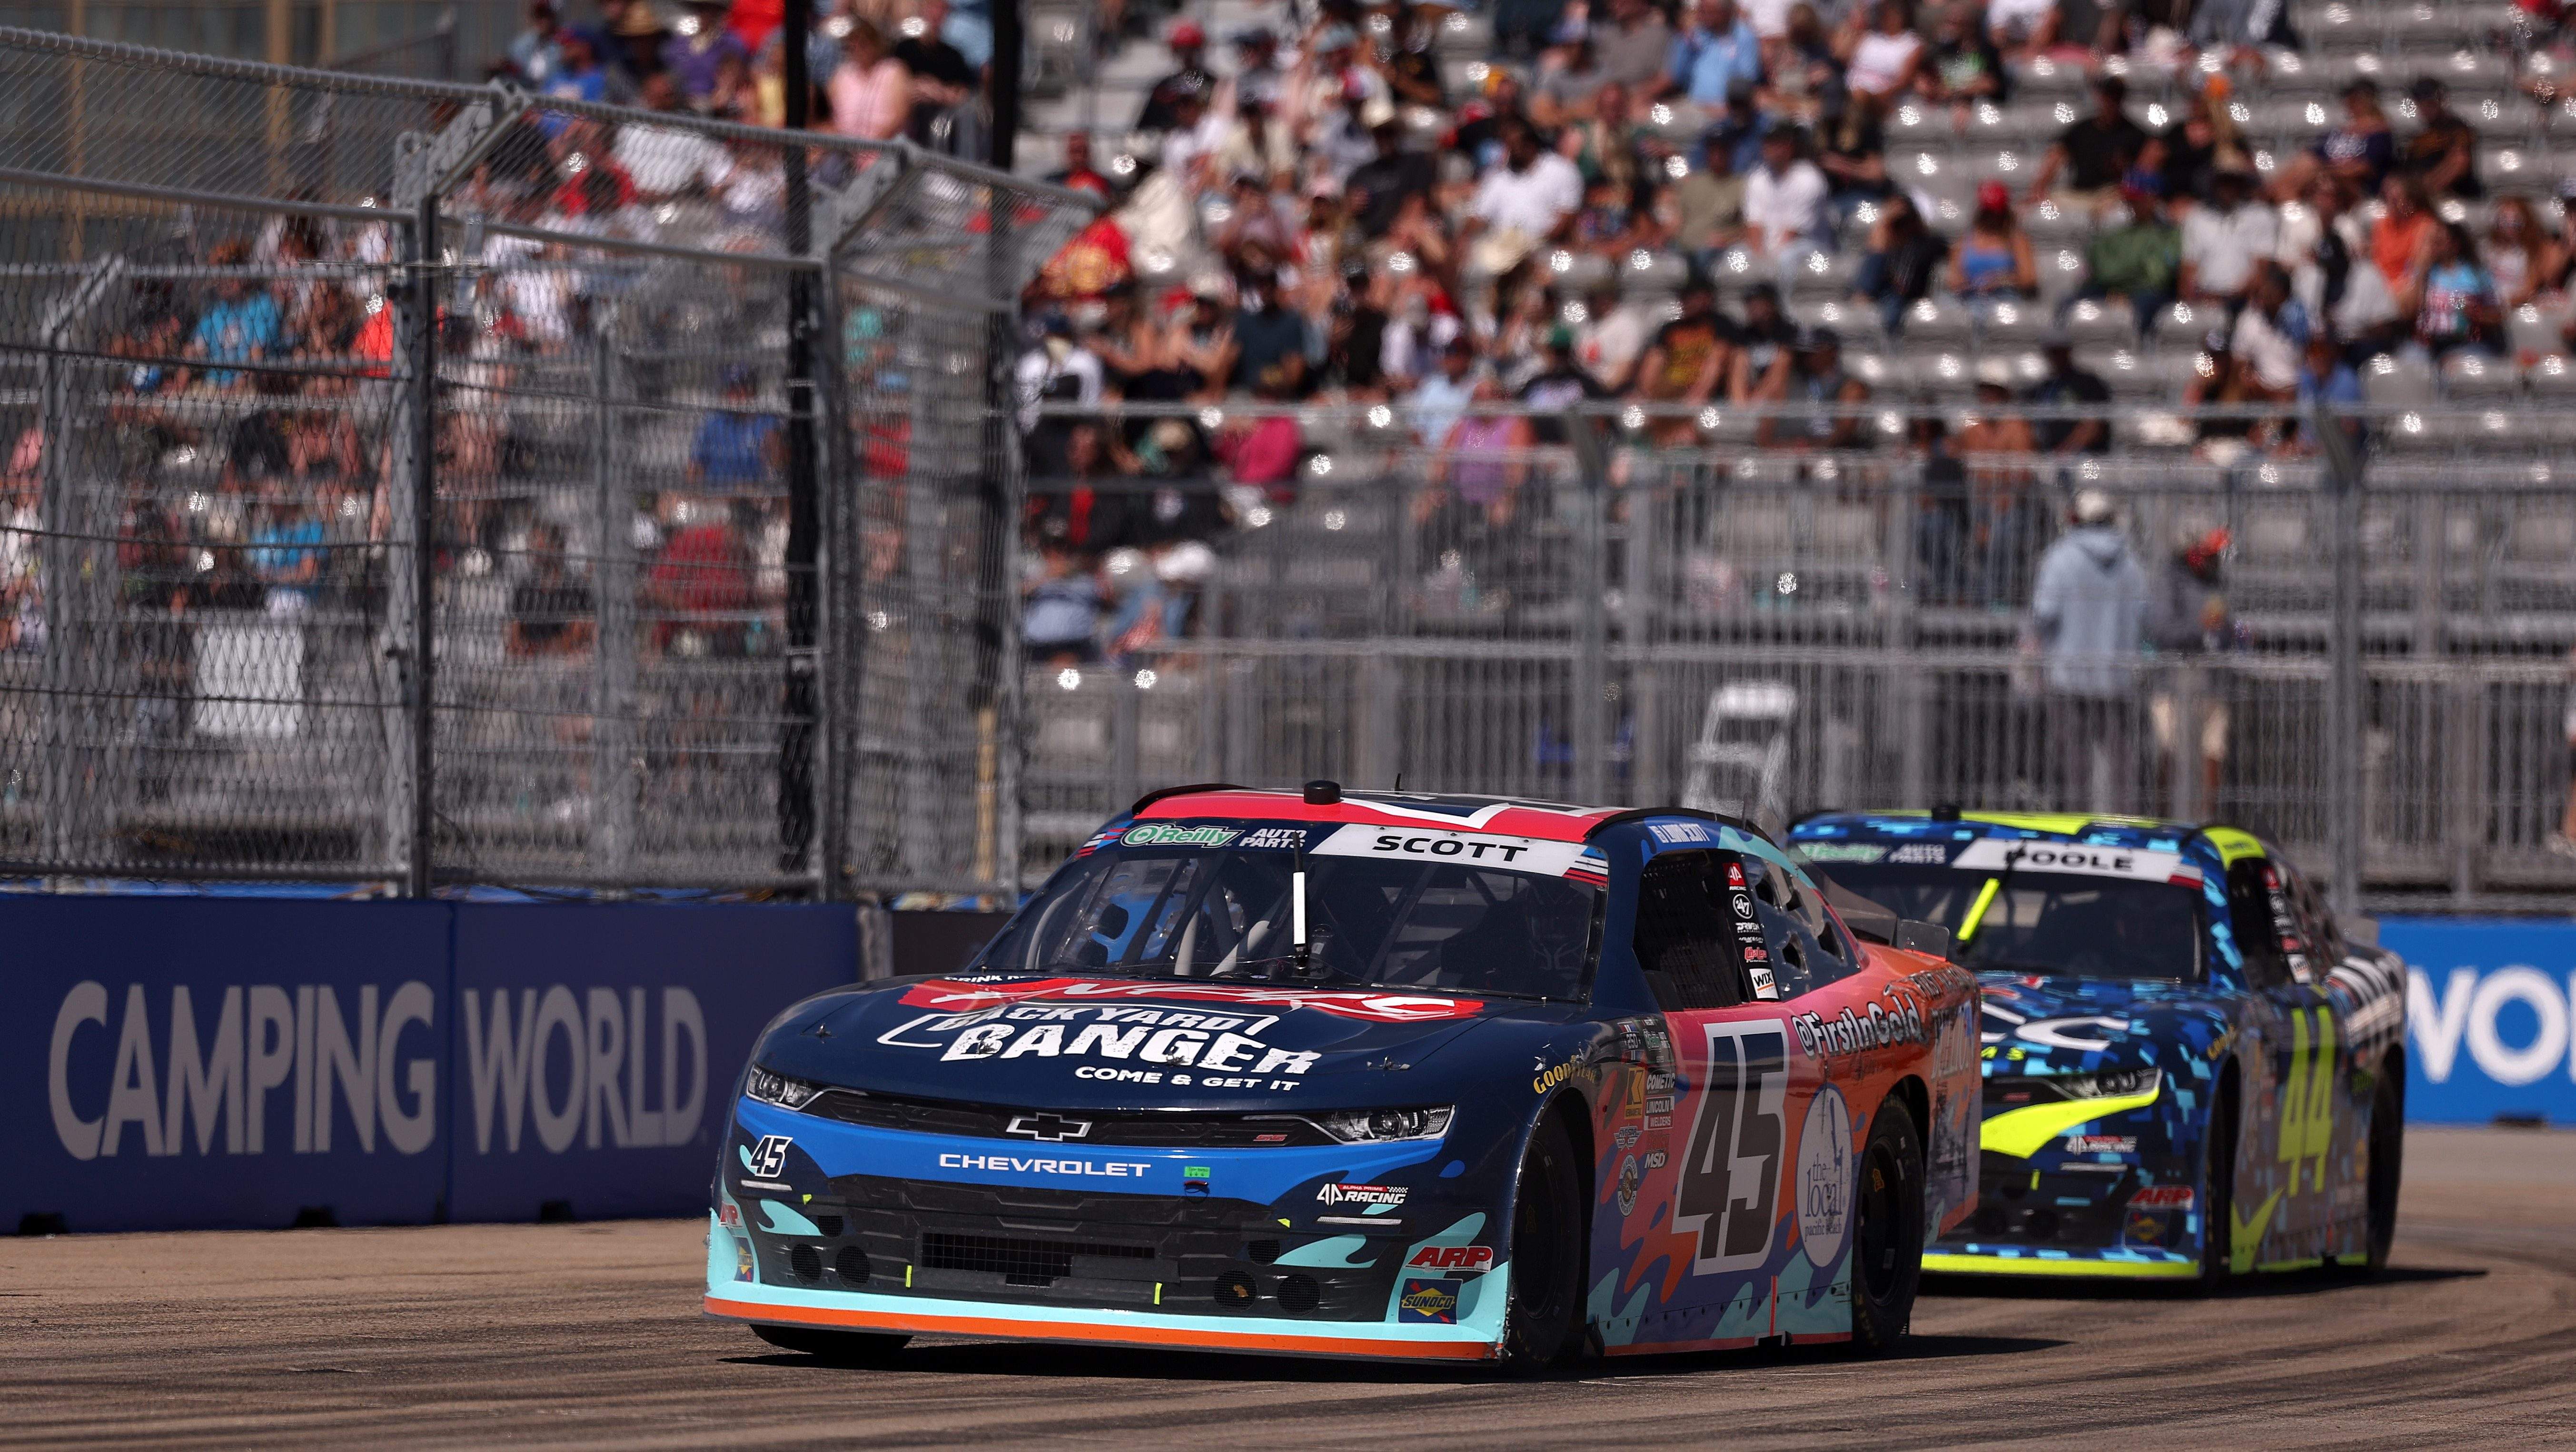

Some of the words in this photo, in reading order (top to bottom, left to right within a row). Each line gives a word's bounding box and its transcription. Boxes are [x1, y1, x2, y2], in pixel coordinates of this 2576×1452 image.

[1125, 824, 1235, 847] O'Reilly
[1239, 837, 1305, 848] PARTS
[1252, 828, 1308, 838] AUTO
[1372, 835, 1528, 862] SCOTT
[1754, 972, 1773, 987] WIX
[1791, 993, 1924, 1057] @FirstInGold
[2407, 964, 2576, 1087] WO
[940, 1024, 1322, 1074] BANGER
[1626, 1034, 1638, 1049] 250
[48, 980, 436, 1161] CAMPING
[462, 984, 708, 1155] WORLD
[1075, 1066, 1162, 1084] COME
[1171, 1074, 1192, 1085] &
[1202, 1077, 1262, 1088] GET
[1270, 1080, 1300, 1091] IT
[1646, 1073, 1675, 1090] COMETIC
[1646, 1100, 1670, 1114] LINCOLN
[2277, 1005, 2335, 1198] 44
[1650, 1116, 1671, 1127] WELDERS
[750, 1135, 793, 1178] 45
[1671, 1018, 1790, 1276] 45
[940, 1154, 1151, 1177] CHEVROLET
[1645, 1153, 1666, 1168] MSD
[1813, 1153, 1831, 1182] the
[1805, 1146, 1843, 1217] local
[1344, 1191, 1406, 1203] RACING
[2132, 1187, 2193, 1204] ARP
[1805, 1218, 1824, 1242] pacific
[1408, 1246, 1493, 1267] ARP
[1403, 1296, 1454, 1308] SUNOCO
